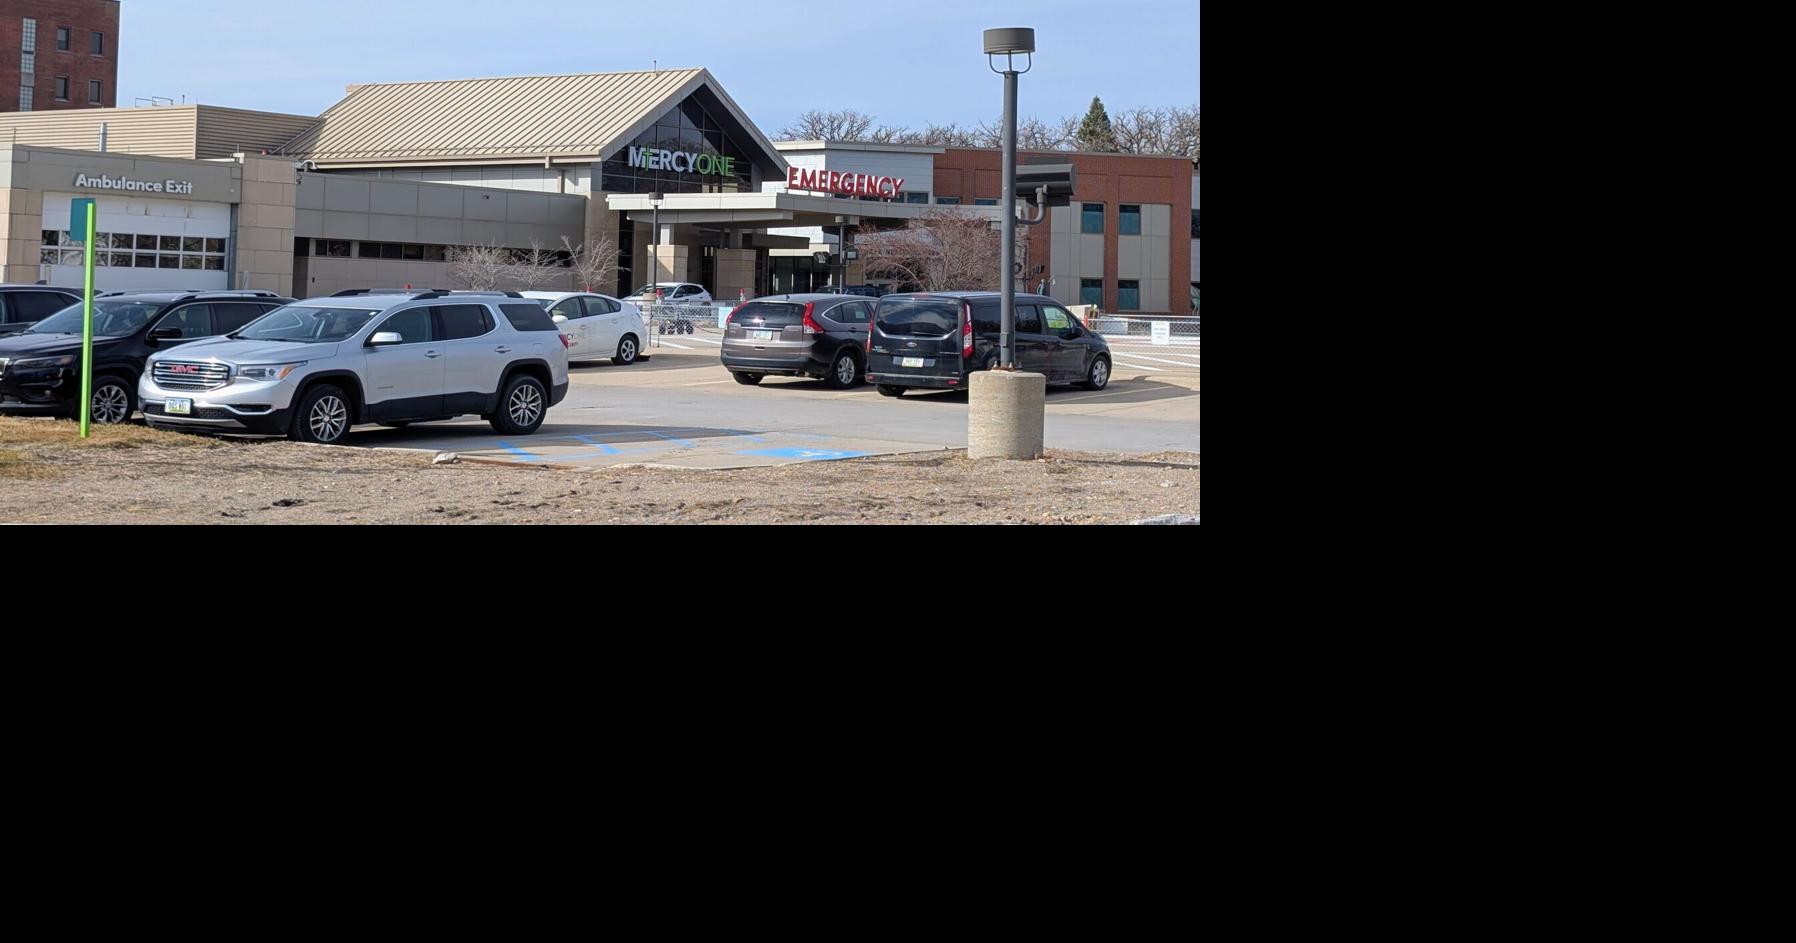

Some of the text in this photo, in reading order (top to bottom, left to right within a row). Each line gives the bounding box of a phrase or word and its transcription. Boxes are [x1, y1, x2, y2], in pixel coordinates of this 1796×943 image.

[629, 145, 735, 176] MERCYONE
[75, 174, 193, 194] Ambulance Exit
[787, 166, 904, 198] EMERGENCY
[169, 365, 200, 374] GMC
